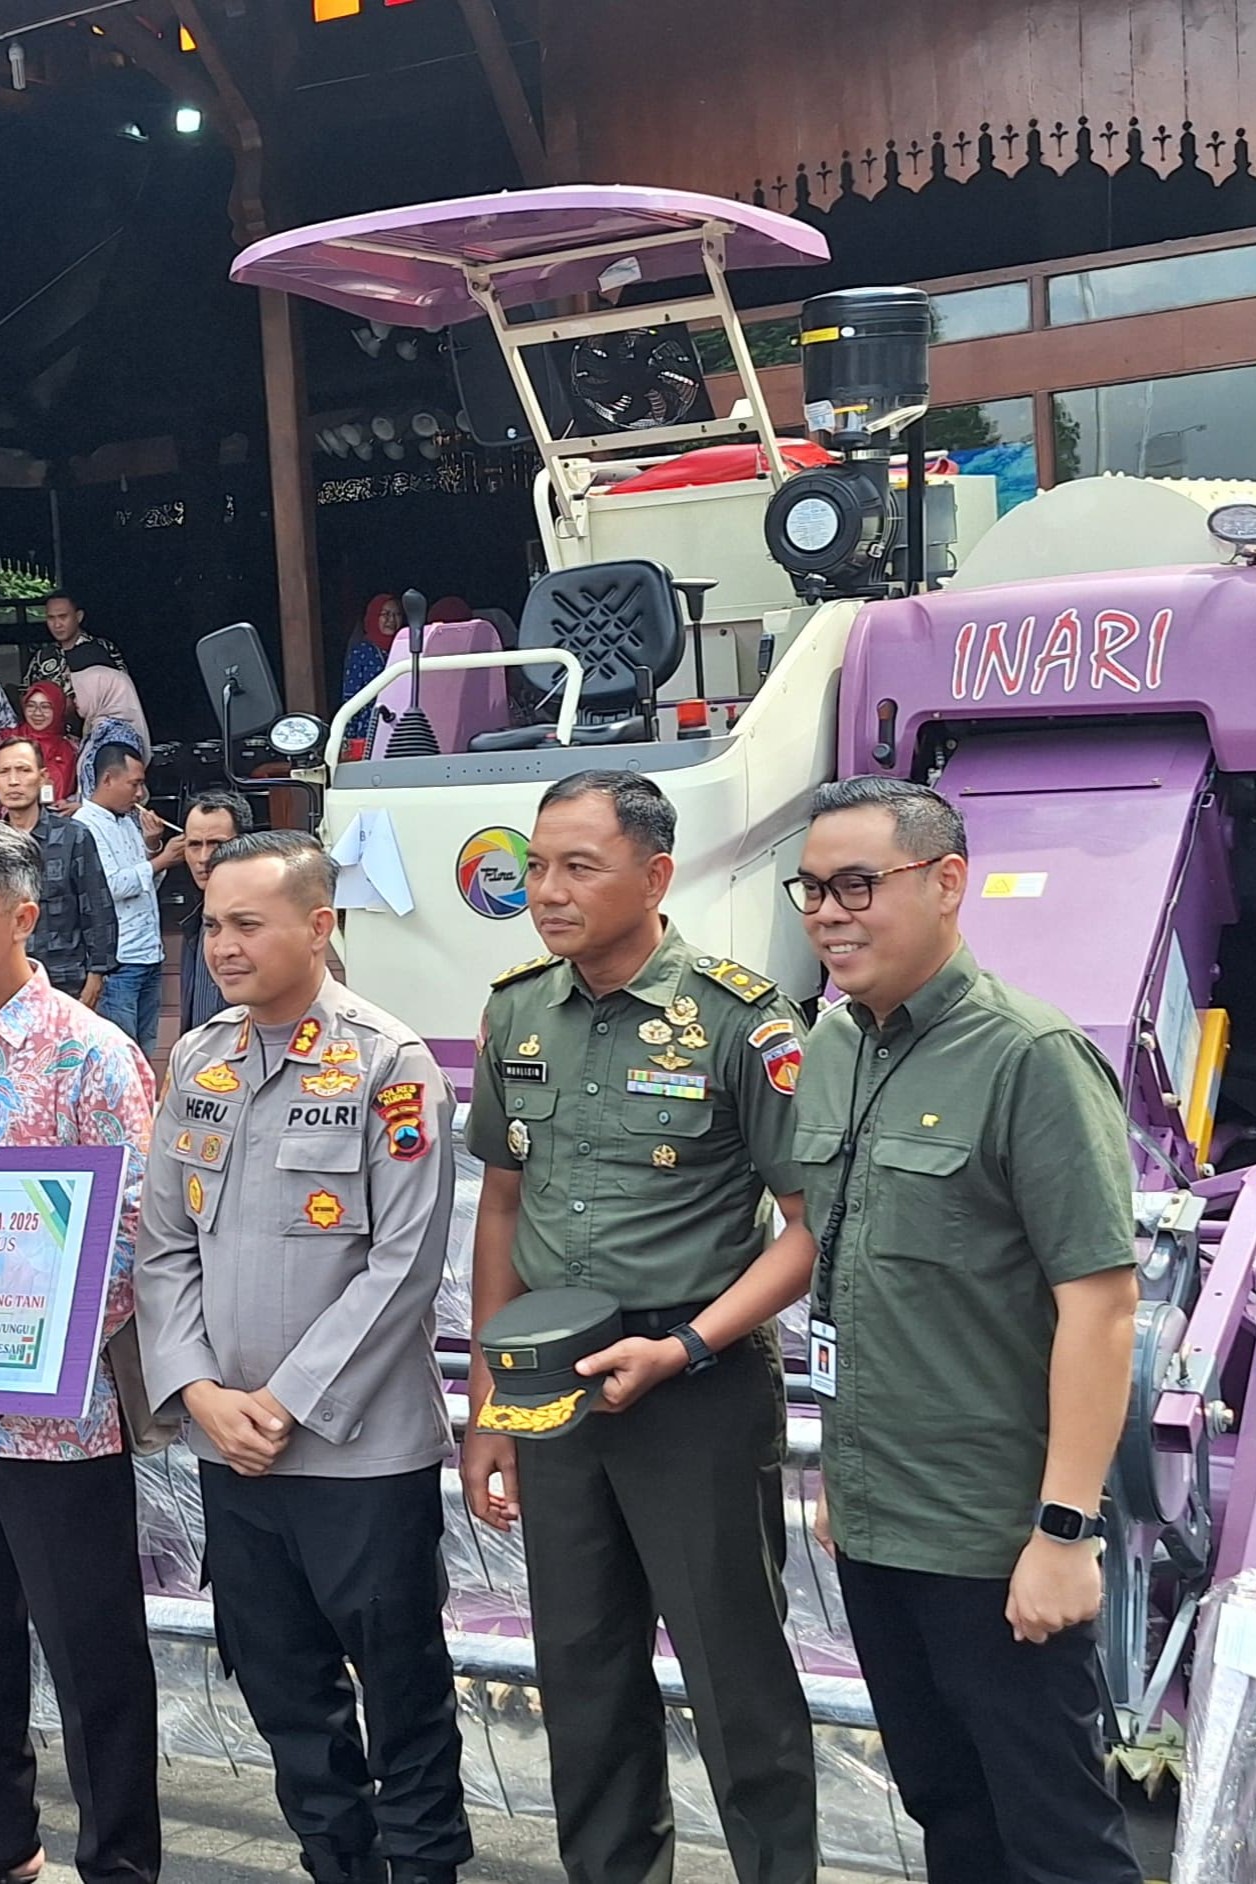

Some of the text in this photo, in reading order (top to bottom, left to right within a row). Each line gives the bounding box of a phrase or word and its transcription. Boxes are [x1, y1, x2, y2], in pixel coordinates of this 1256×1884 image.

[952, 608, 1172, 700] INARI
[186, 1097, 228, 1123] HERU
[287, 1105, 357, 1126] POLRI
[9, 1212, 39, 1231] 2025
[15, 1294, 45, 1309] TANI
